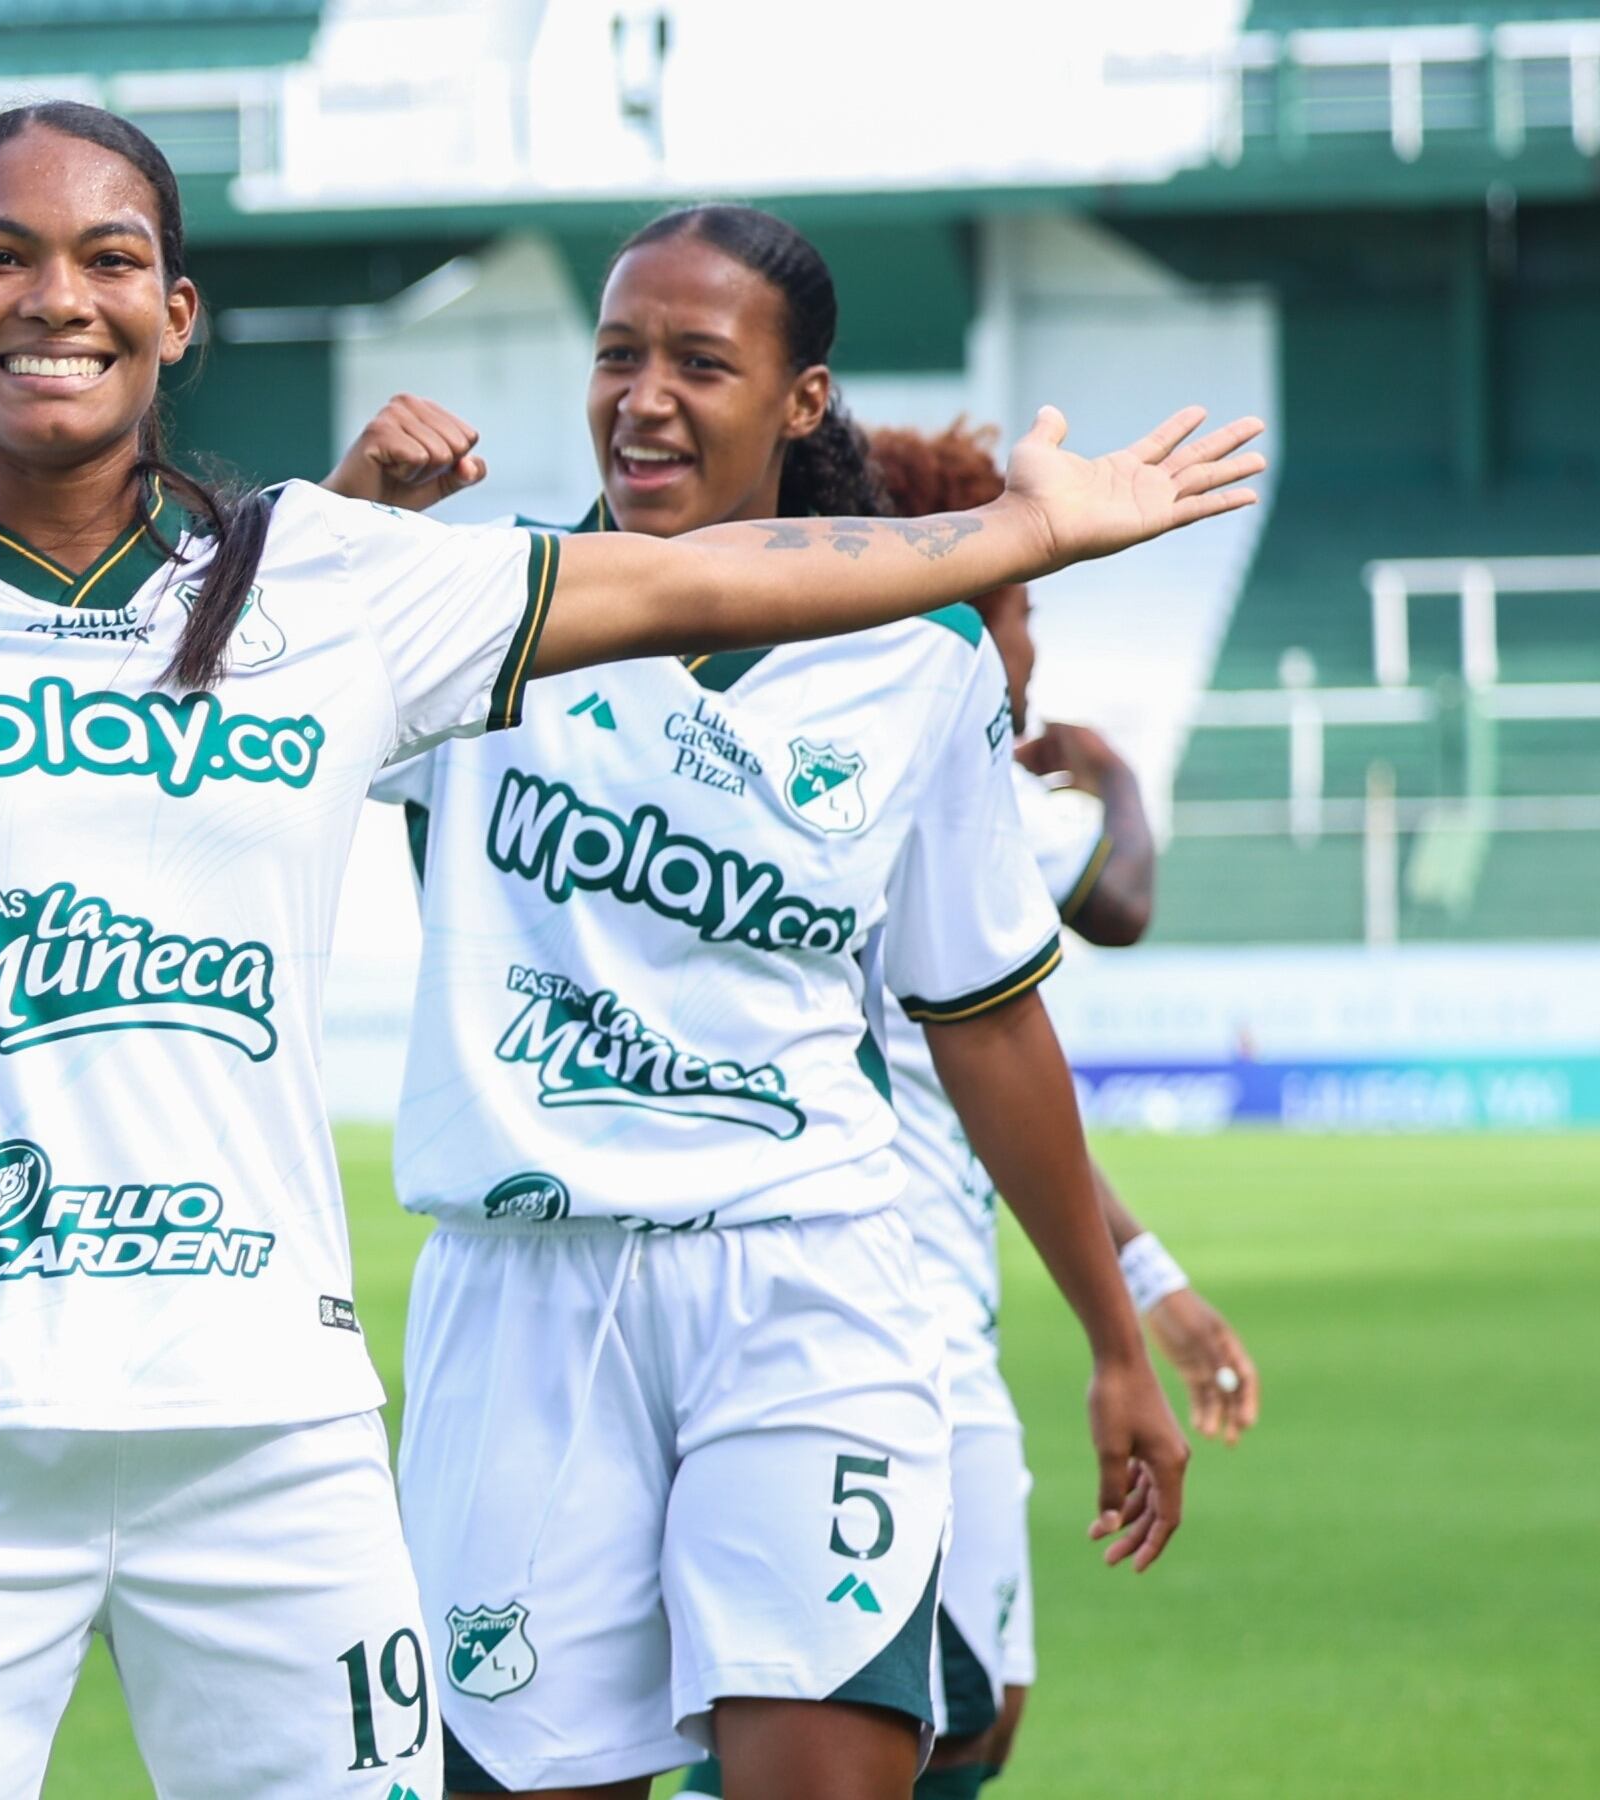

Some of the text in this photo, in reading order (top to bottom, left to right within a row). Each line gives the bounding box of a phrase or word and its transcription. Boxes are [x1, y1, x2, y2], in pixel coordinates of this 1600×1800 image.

[664, 711, 763, 776] Caesars
[671, 746, 746, 797] Pizza
[36, 887, 103, 940] La
[42, 1184, 221, 1230] FLUO
[829, 1454, 895, 1561] 5
[336, 1627, 430, 1772] 19
